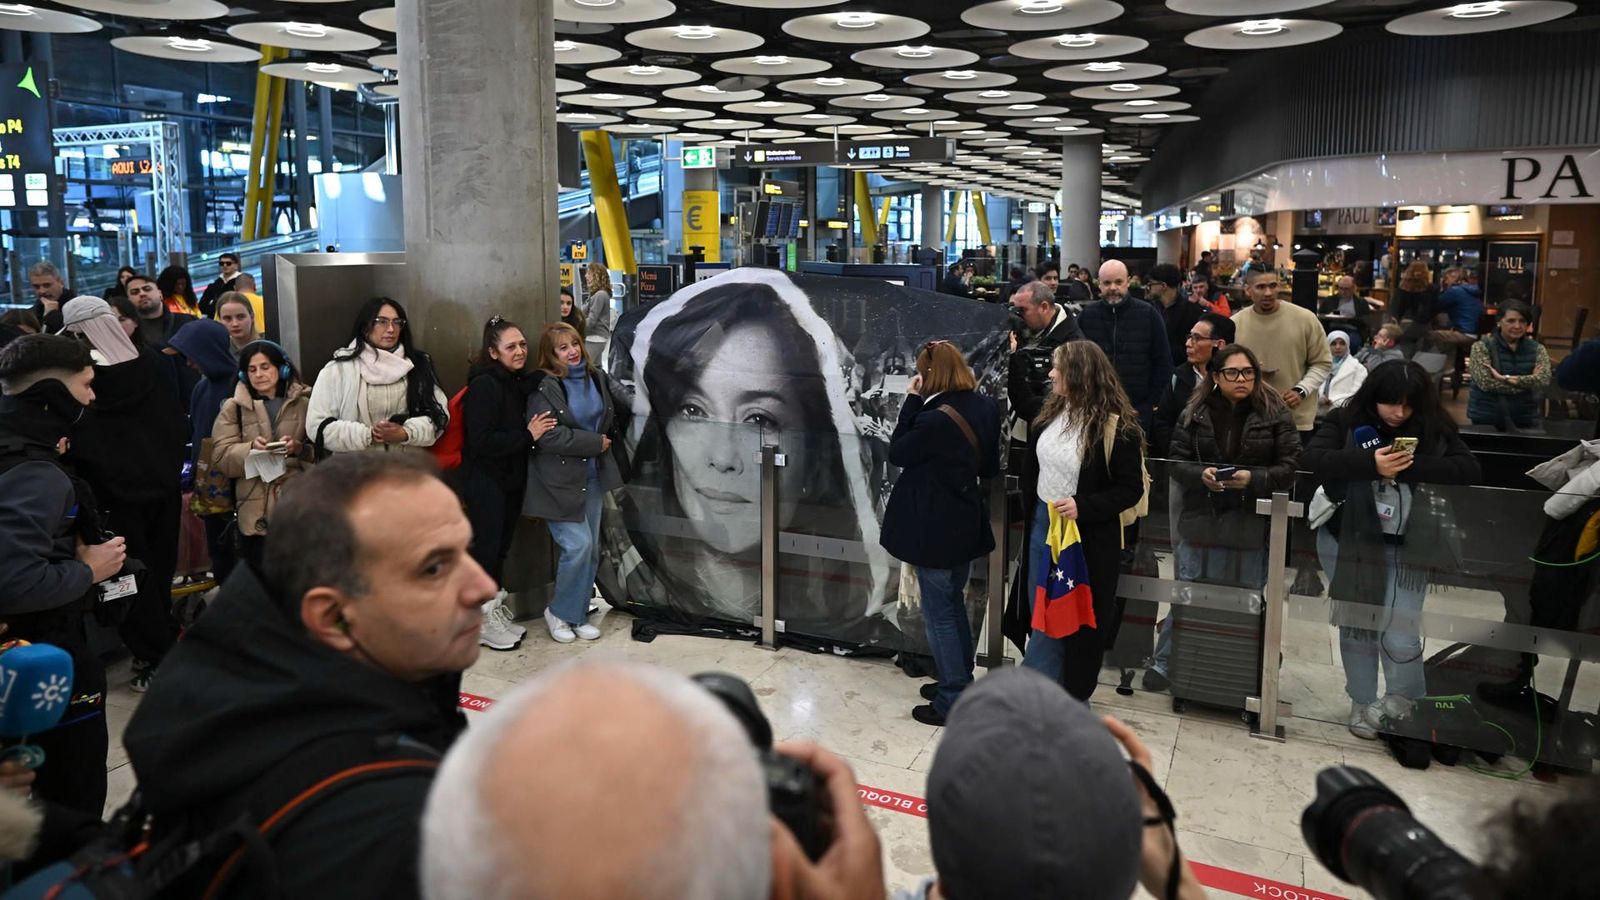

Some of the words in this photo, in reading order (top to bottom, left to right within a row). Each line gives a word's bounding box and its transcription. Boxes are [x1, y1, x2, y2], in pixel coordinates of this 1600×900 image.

[7, 119, 22, 133] P4
[5, 155, 20, 168] T4
[1500, 155, 1594, 200] PA
[1337, 207, 1370, 225] PAUL
[1497, 256, 1524, 270] PAUL
[640, 281, 656, 291] Pizza
[118, 582, 131, 593] 27
[1435, 701, 1456, 709] TVU
[917, 803, 929, 813] O
